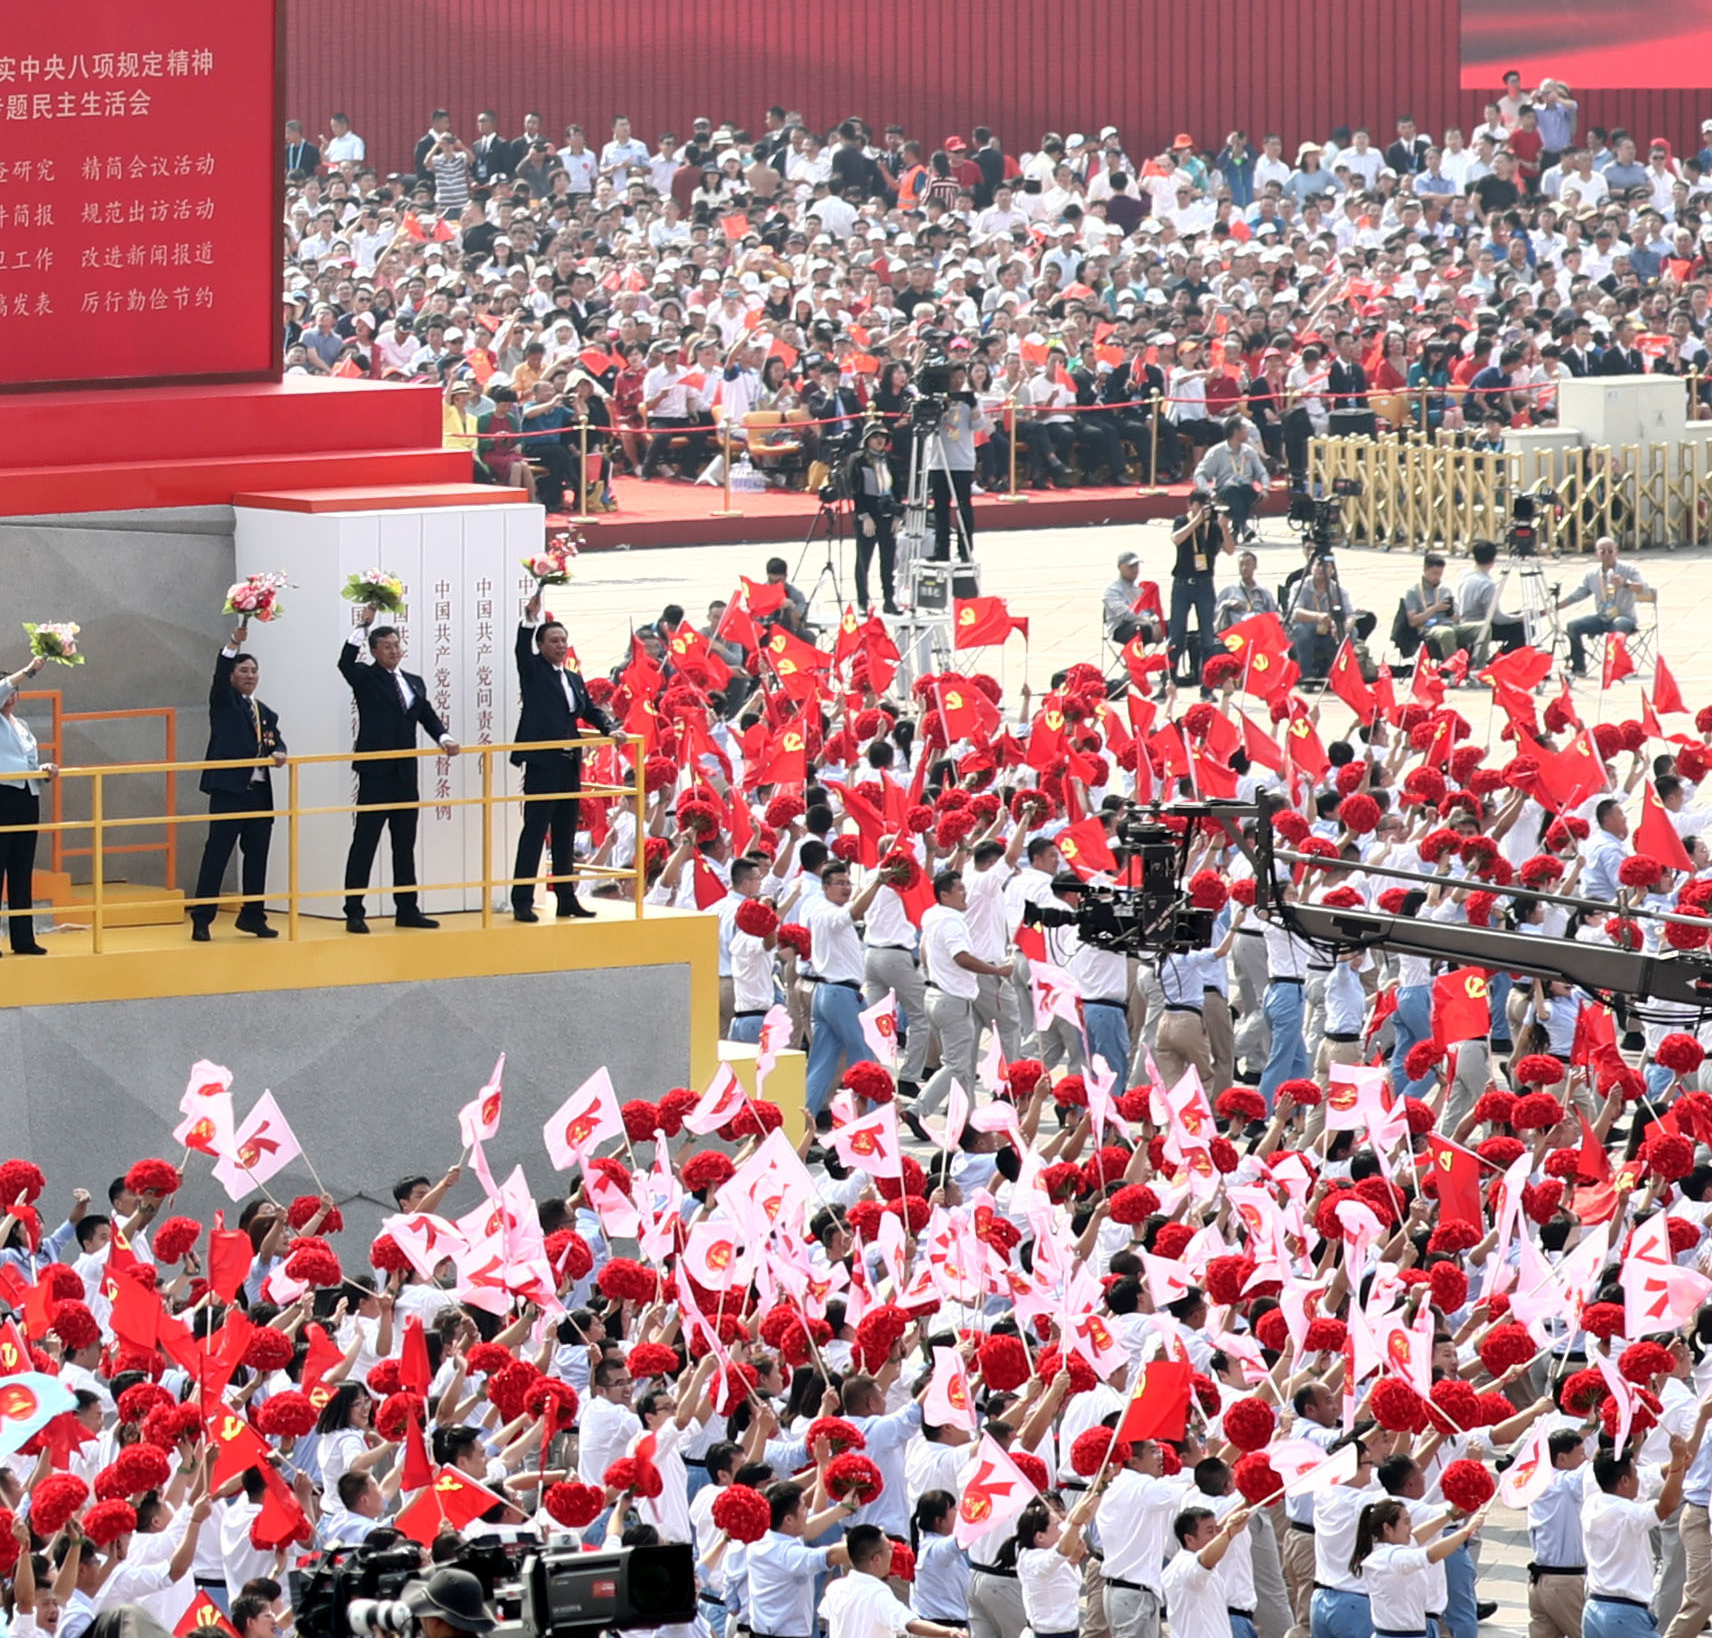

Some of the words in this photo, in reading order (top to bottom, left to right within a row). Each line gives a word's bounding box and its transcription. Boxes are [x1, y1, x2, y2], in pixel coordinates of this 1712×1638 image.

[81, 152, 217, 182] 精简会议活动
[81, 197, 217, 225] 规范出访活动
[81, 241, 216, 270] 改进新闻报道
[80, 286, 215, 314] 厉行勤俭节约
